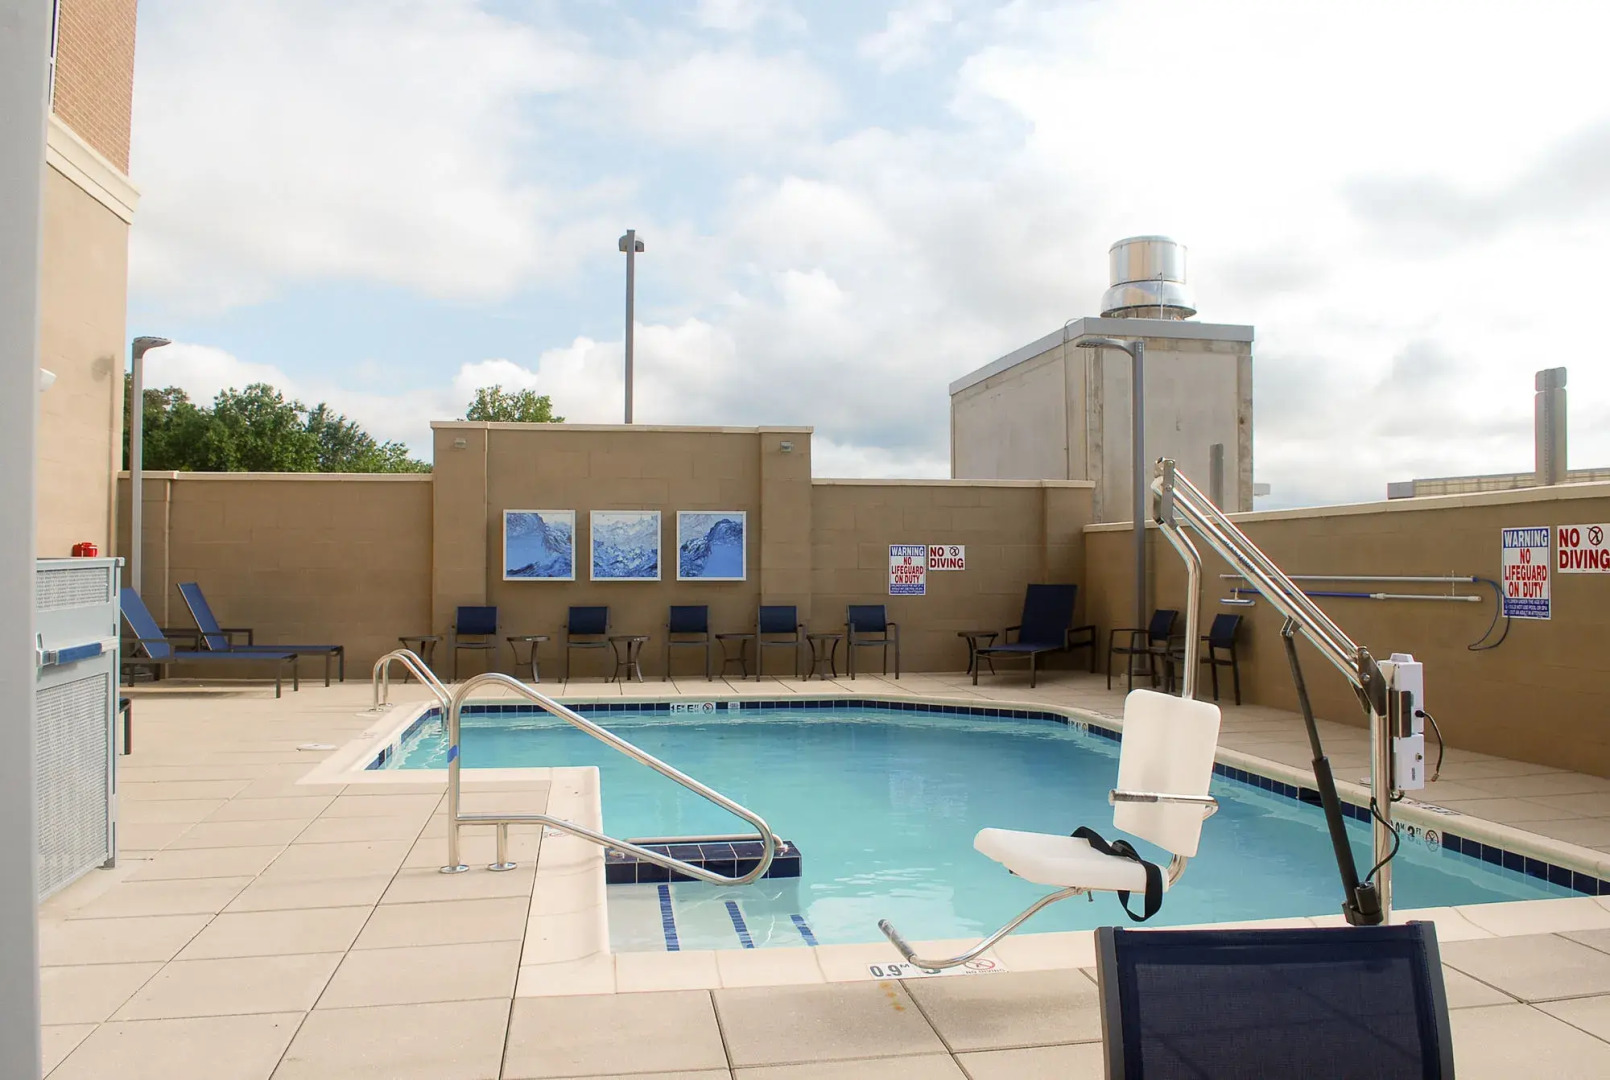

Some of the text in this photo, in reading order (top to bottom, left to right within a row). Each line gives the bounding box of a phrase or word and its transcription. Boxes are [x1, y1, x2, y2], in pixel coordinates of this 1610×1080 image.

[1504, 530, 1547, 547] WARNING
[1559, 528, 1580, 547] NO
[892, 547, 923, 556] WARNING
[930, 547, 944, 557] NO
[1520, 548, 1531, 564] NO
[903, 557, 912, 565] NO
[930, 558, 964, 568] DIVING
[1559, 549, 1610, 569] DIVING
[891, 566, 924, 575] LIFEGUARD
[1504, 565, 1547, 581] LIFEGUARD
[895, 575, 920, 583] ON DUTY
[1508, 581, 1543, 598] ON DUTY
